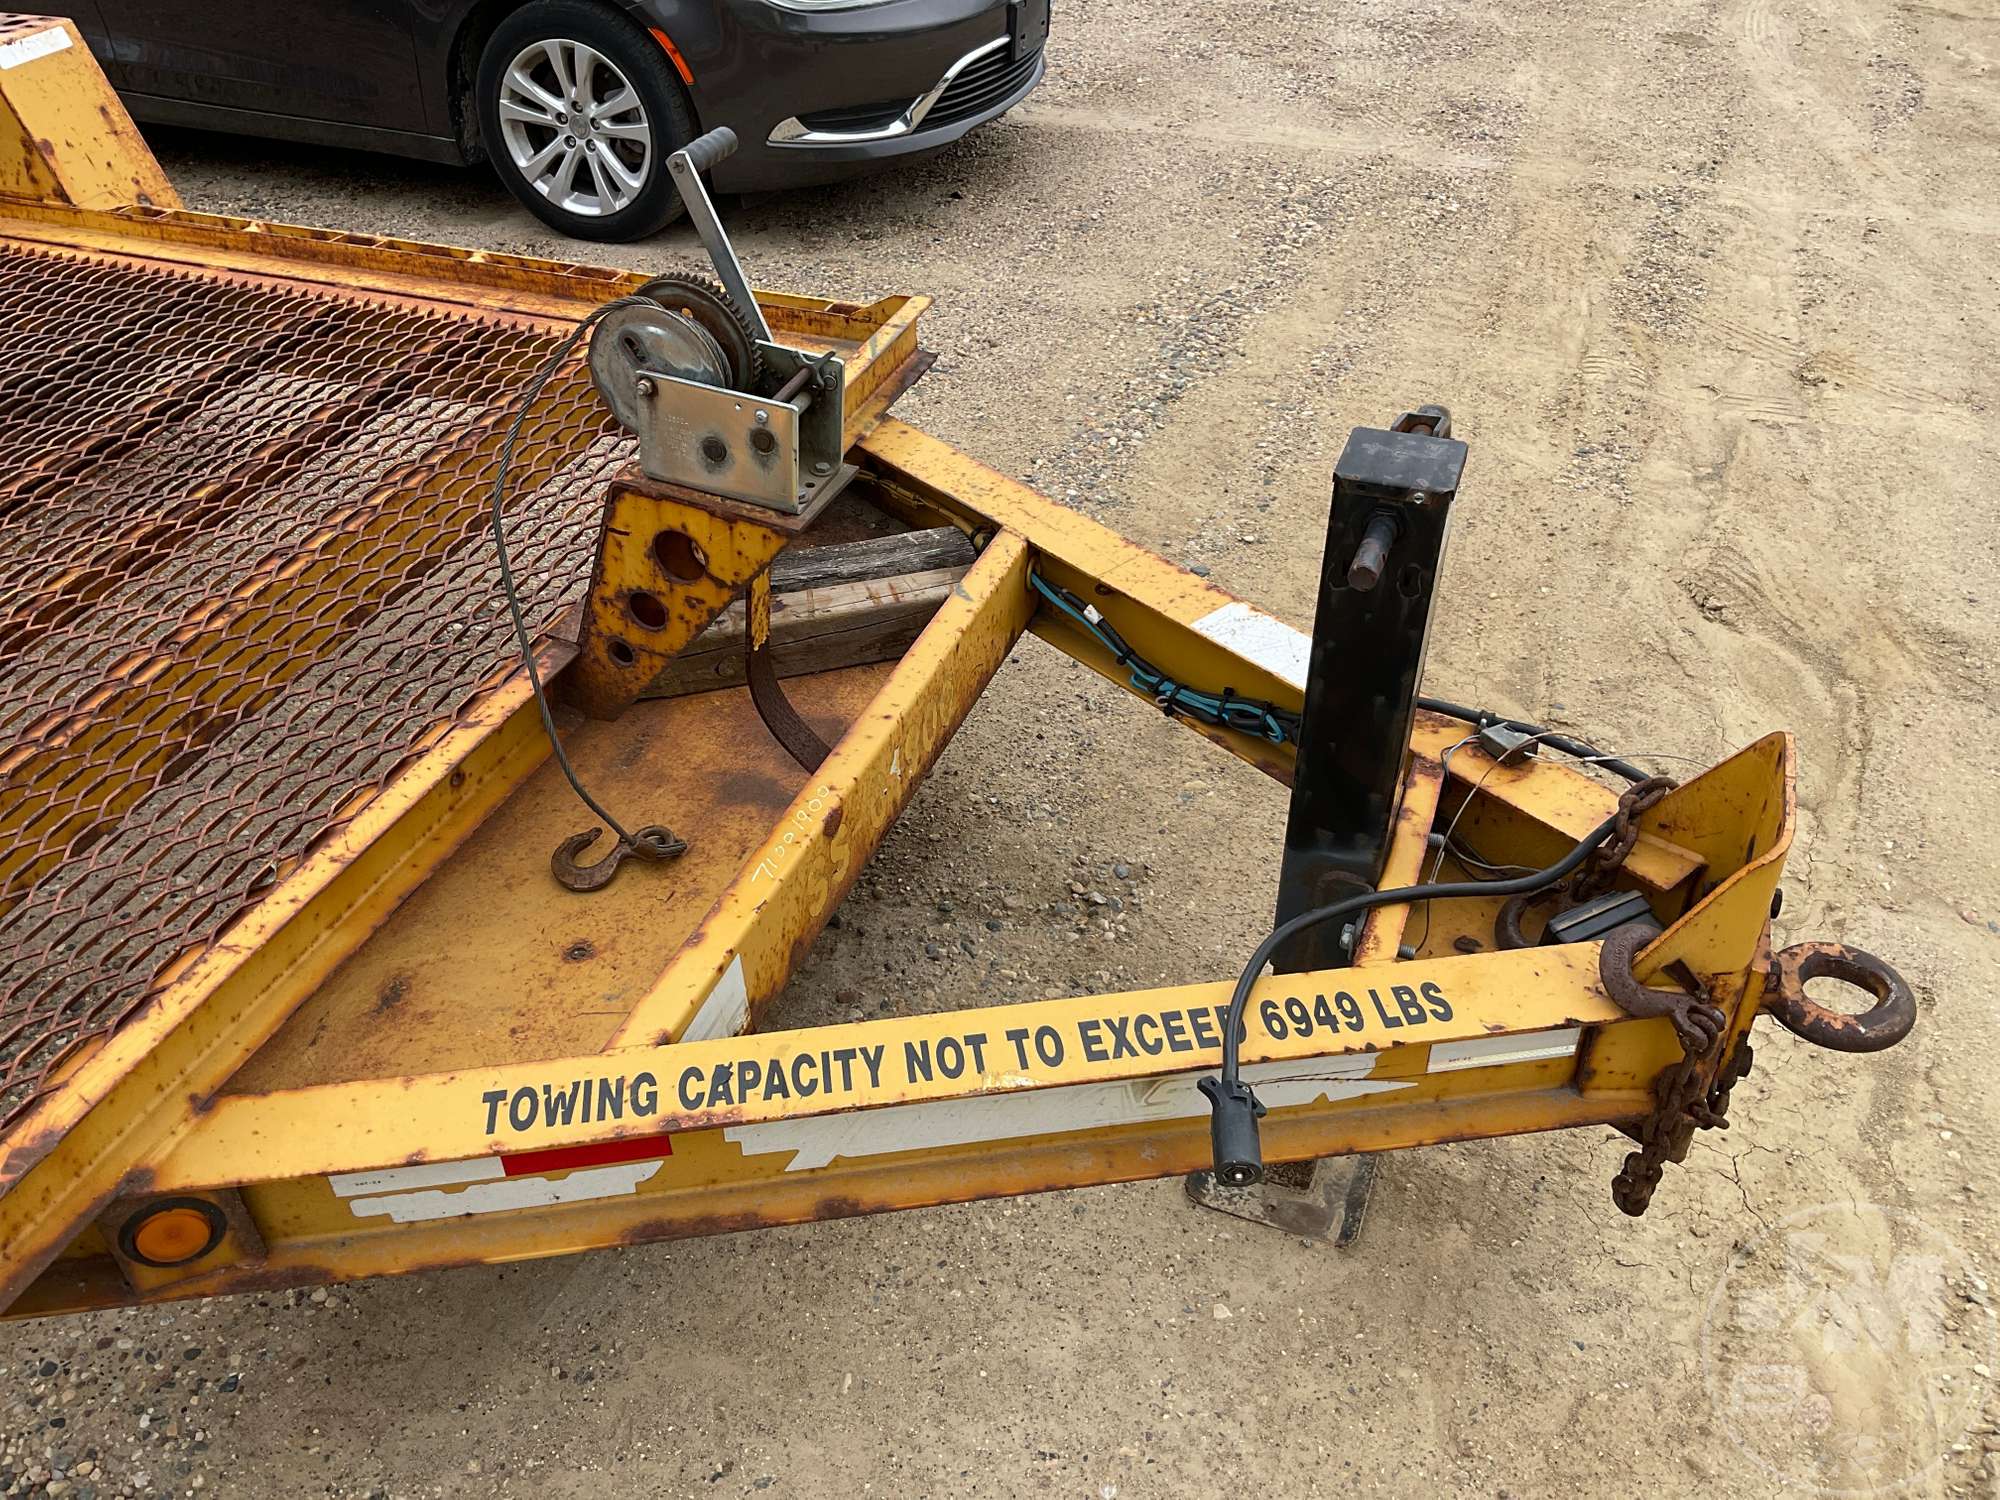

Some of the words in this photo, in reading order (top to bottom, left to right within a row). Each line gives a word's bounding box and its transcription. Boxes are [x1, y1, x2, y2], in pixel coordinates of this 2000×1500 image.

[482, 1071, 658, 1135] TOWING
[678, 1044, 885, 1111] CAPACITY
[904, 1032, 988, 1084] NOT
[1006, 1024, 1065, 1070] TO
[1259, 991, 1365, 1041] 6949
[1369, 981, 1454, 1030] LBS
